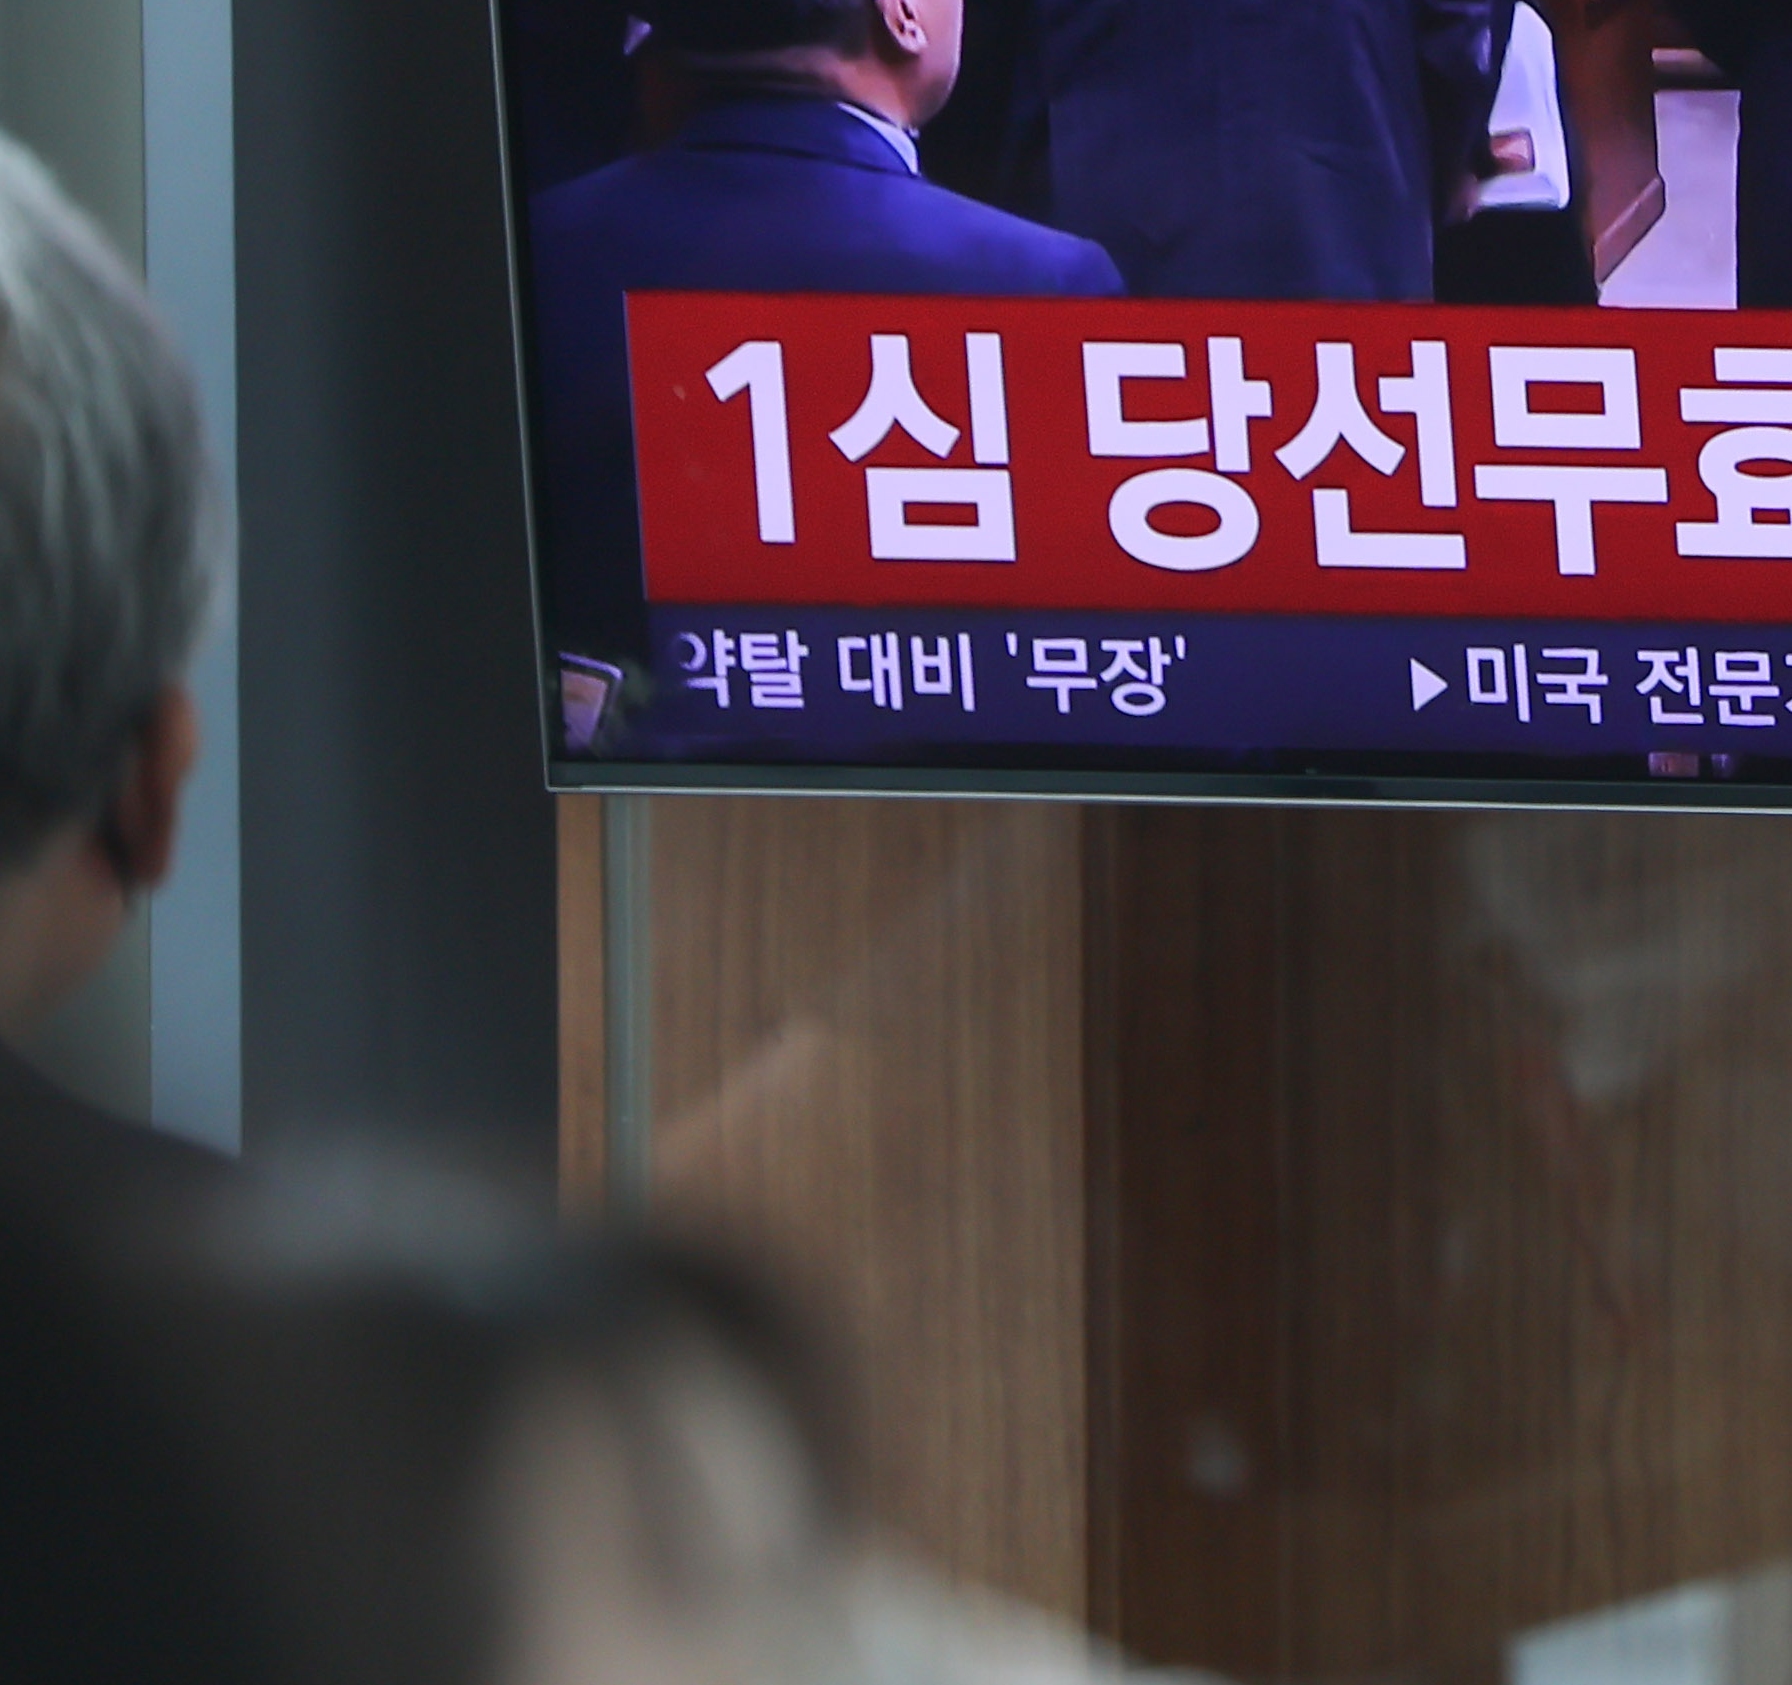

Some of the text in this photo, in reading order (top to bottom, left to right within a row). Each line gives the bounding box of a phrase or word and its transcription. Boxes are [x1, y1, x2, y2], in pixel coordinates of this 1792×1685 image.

[707, 334, 1015, 560] 1심
[839, 633, 973, 709] 대비
[1008, 634, 1184, 714] '무장'
[1468, 645, 1607, 723] 미국
